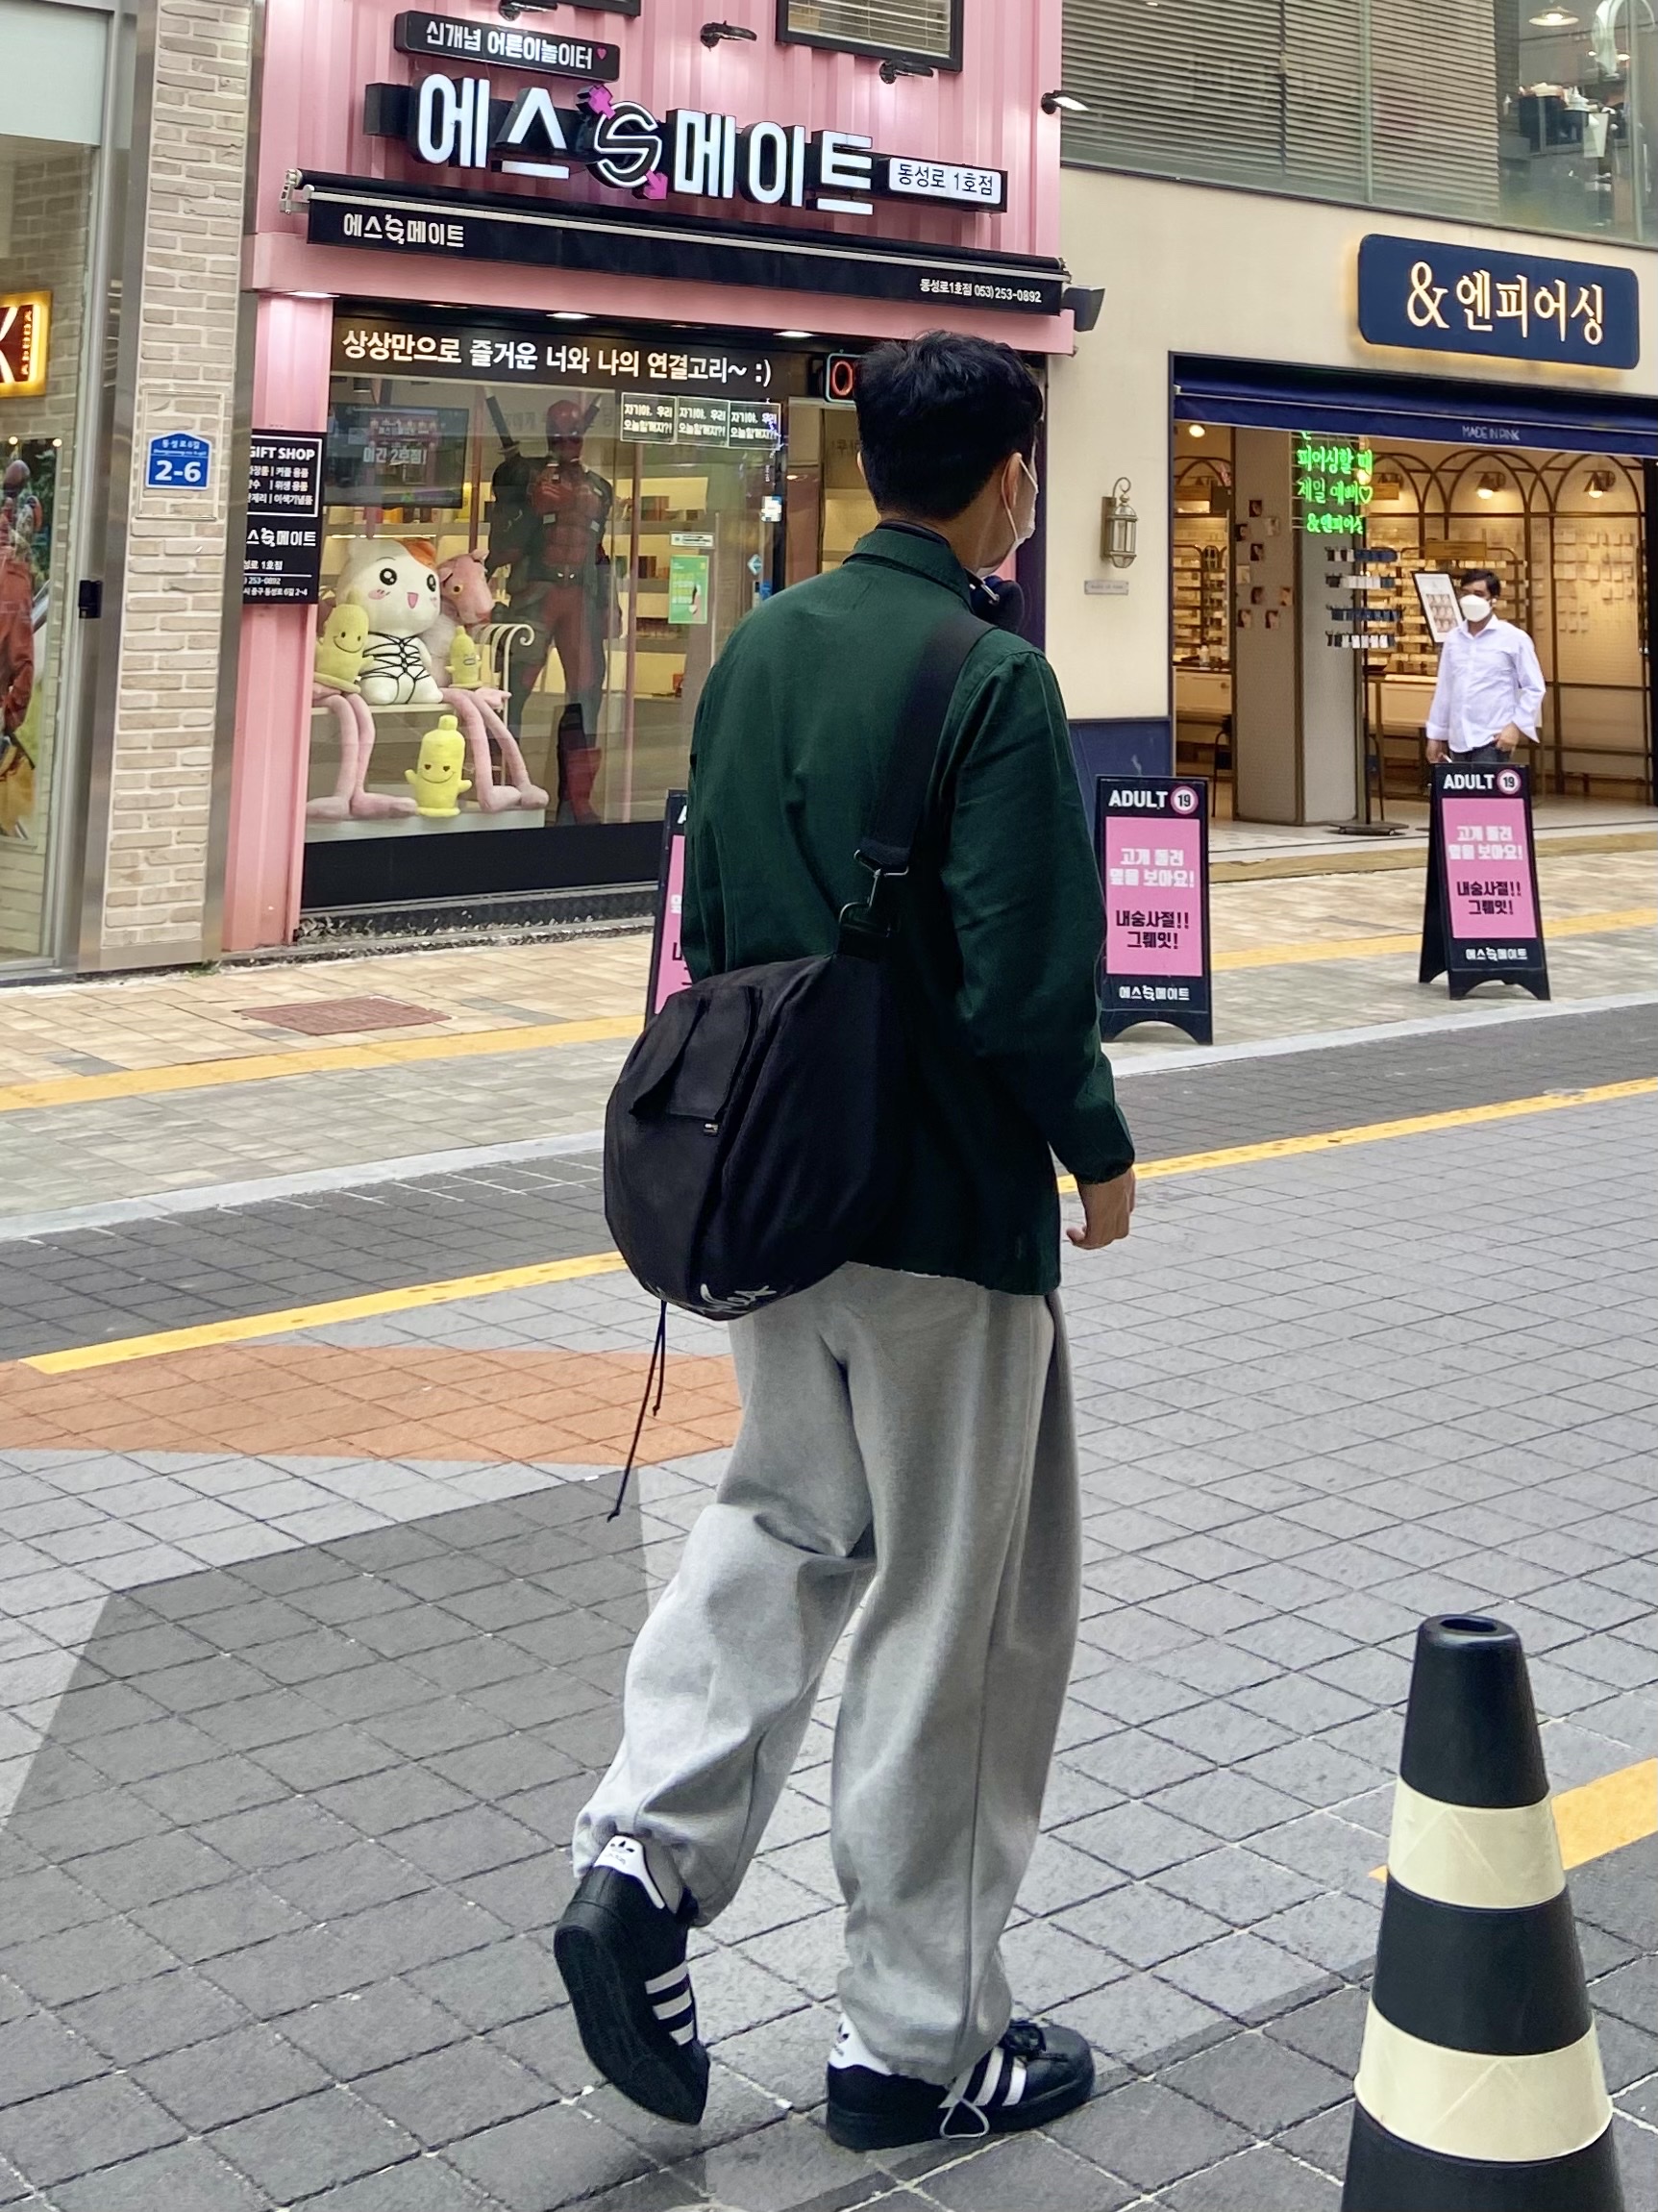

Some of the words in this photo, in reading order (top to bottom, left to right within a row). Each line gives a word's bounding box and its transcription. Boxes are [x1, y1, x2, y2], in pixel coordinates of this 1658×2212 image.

[426, 20, 482, 52] 신개념
[487, 30, 593, 70] 어른이놀이터
[897, 163, 946, 188] 동성로
[953, 171, 993, 196] 1호점
[342, 330, 462, 363] 상상만으로
[469, 338, 538, 370] 즐거운
[546, 345, 590, 374] 너와
[598, 349, 639, 377] 나의
[656, 405, 673, 418] 우리
[710, 409, 727, 421] 우리
[1462, 425, 1488, 439] MADE
[278, 447, 316, 460] SHOP
[1298, 444, 1354, 475] 피어싱할
[154, 460, 202, 483] 2-6
[1297, 477, 1325, 504] 제일
[1444, 773, 1496, 790] ADULT
[1502, 776, 1515, 788] 19
[1108, 789, 1169, 808] ADULT
[1177, 793, 1192, 808] 19
[1456, 825, 1484, 842] 고개
[1120, 848, 1151, 866] 고개
[1477, 844, 1523, 861] 보아요!
[1143, 868, 1195, 889] 보아요!
[1456, 881, 1522, 897] 내숭사절!!
[1116, 909, 1189, 930] 내숭사절!!
